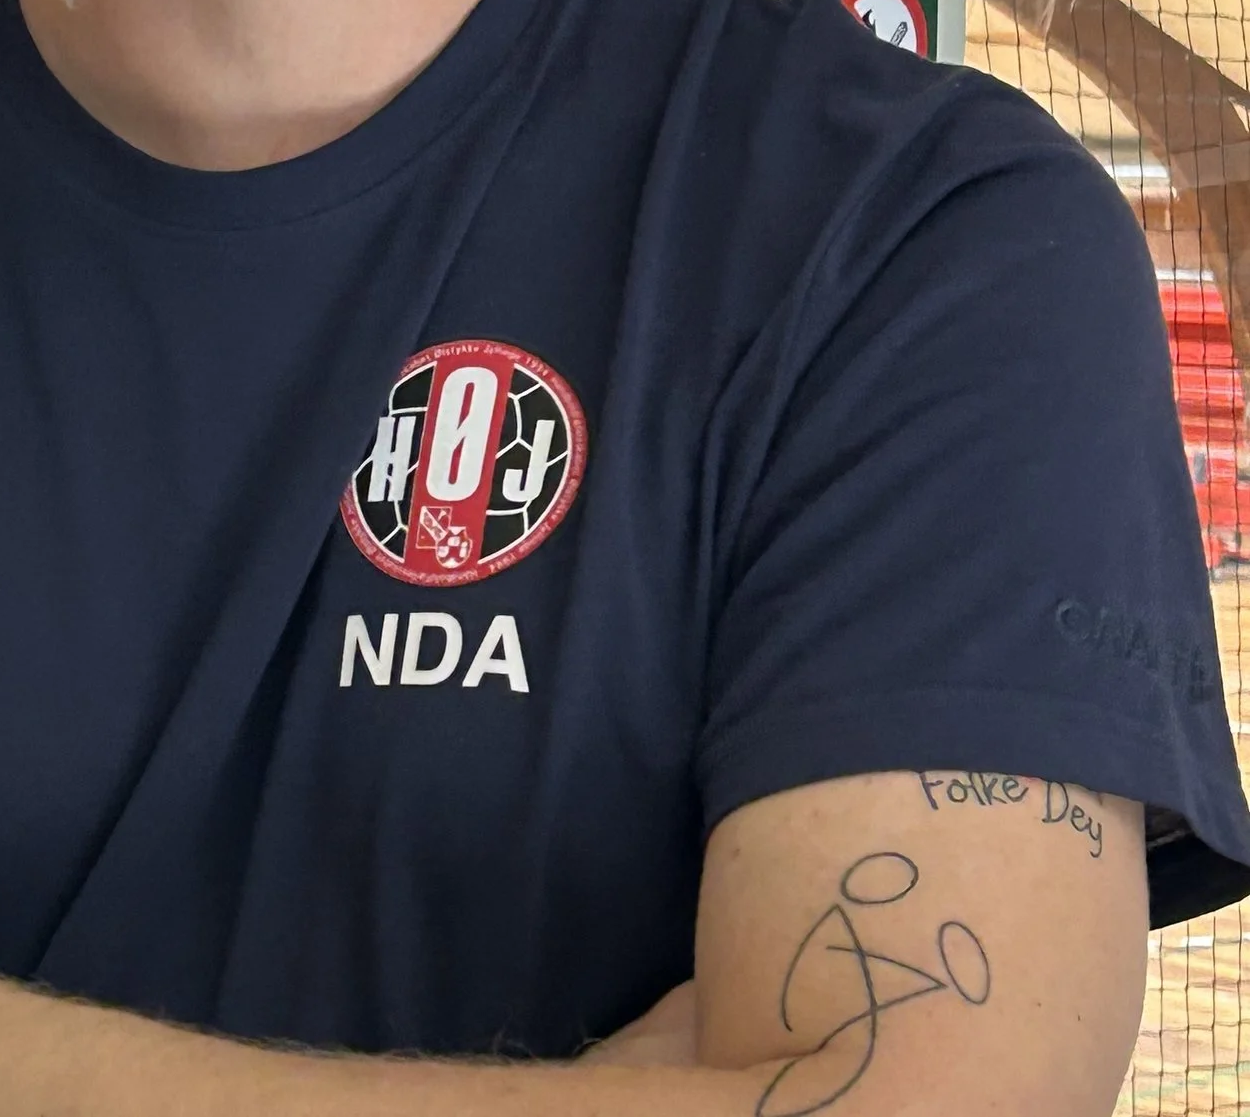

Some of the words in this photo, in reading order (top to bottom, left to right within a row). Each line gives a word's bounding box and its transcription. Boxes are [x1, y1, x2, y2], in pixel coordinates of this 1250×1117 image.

[339, 611, 530, 693] NDA
[918, 771, 1030, 811] Folke
[1041, 780, 1103, 859] Dey
